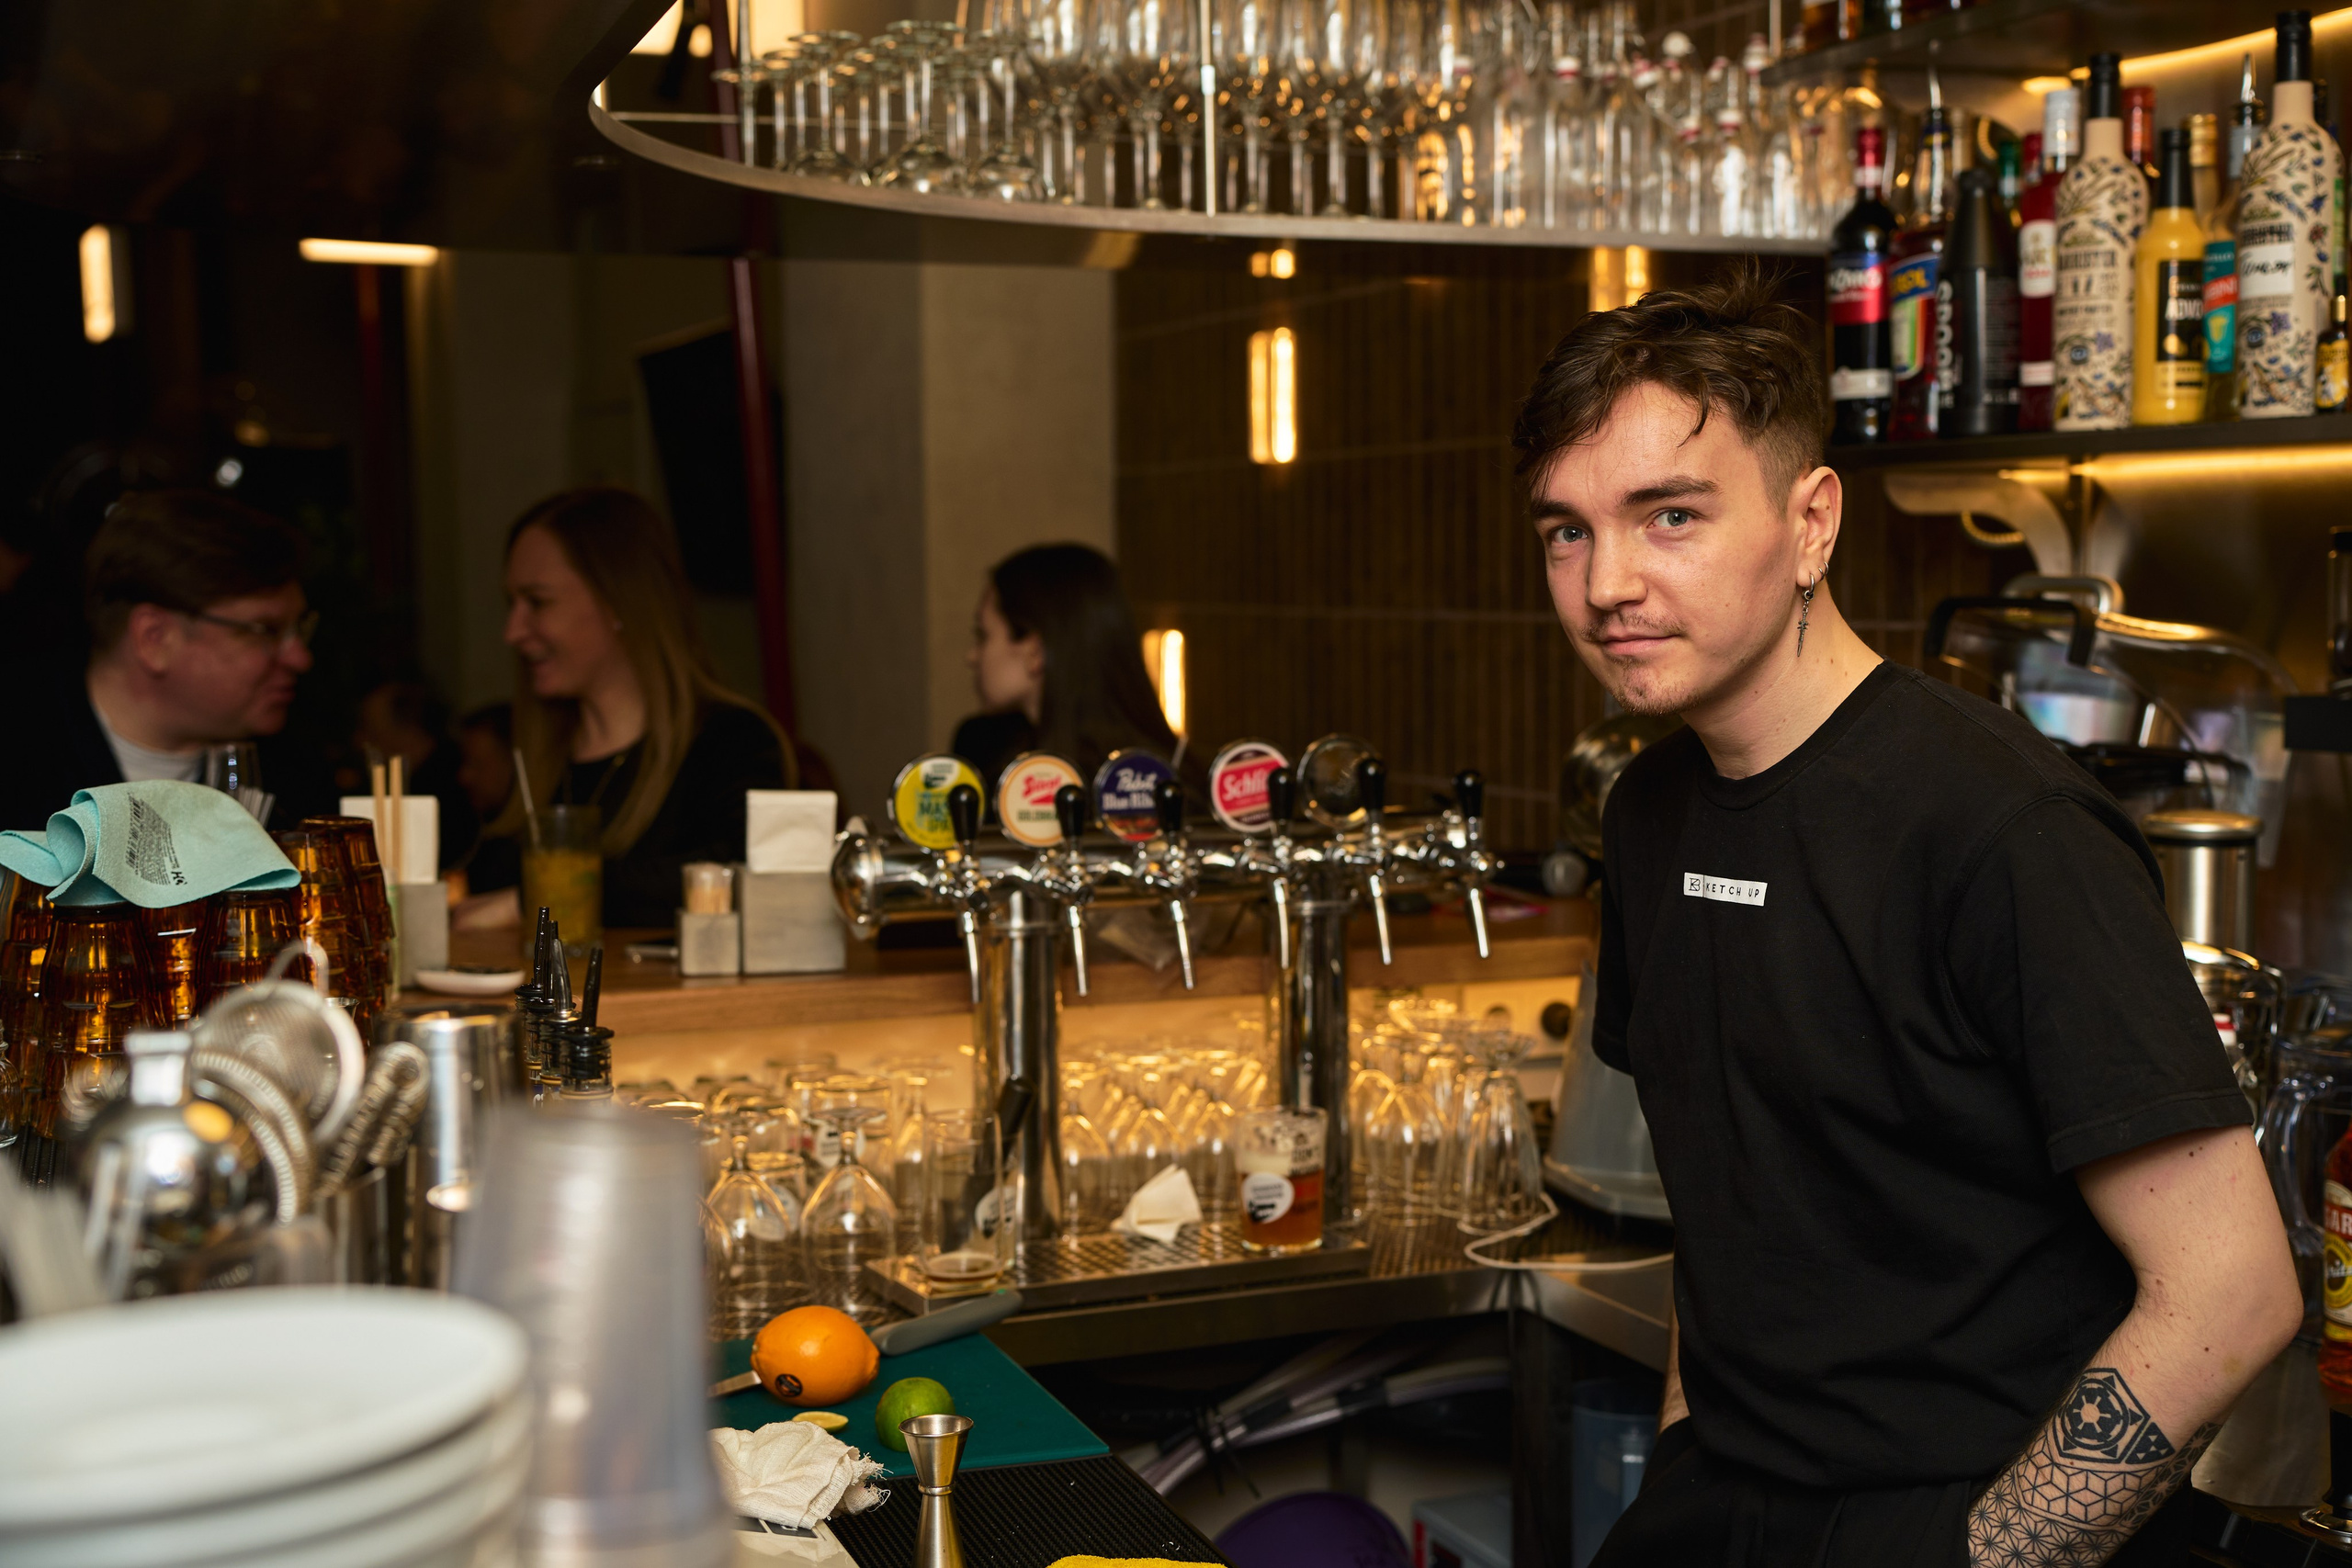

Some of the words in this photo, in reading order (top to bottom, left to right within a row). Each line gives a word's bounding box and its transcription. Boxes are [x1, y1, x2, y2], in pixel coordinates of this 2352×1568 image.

[1116, 767, 1158, 792] Pabst
[1706, 883, 1741, 896] KETCH
[1747, 888, 1760, 898] UP
